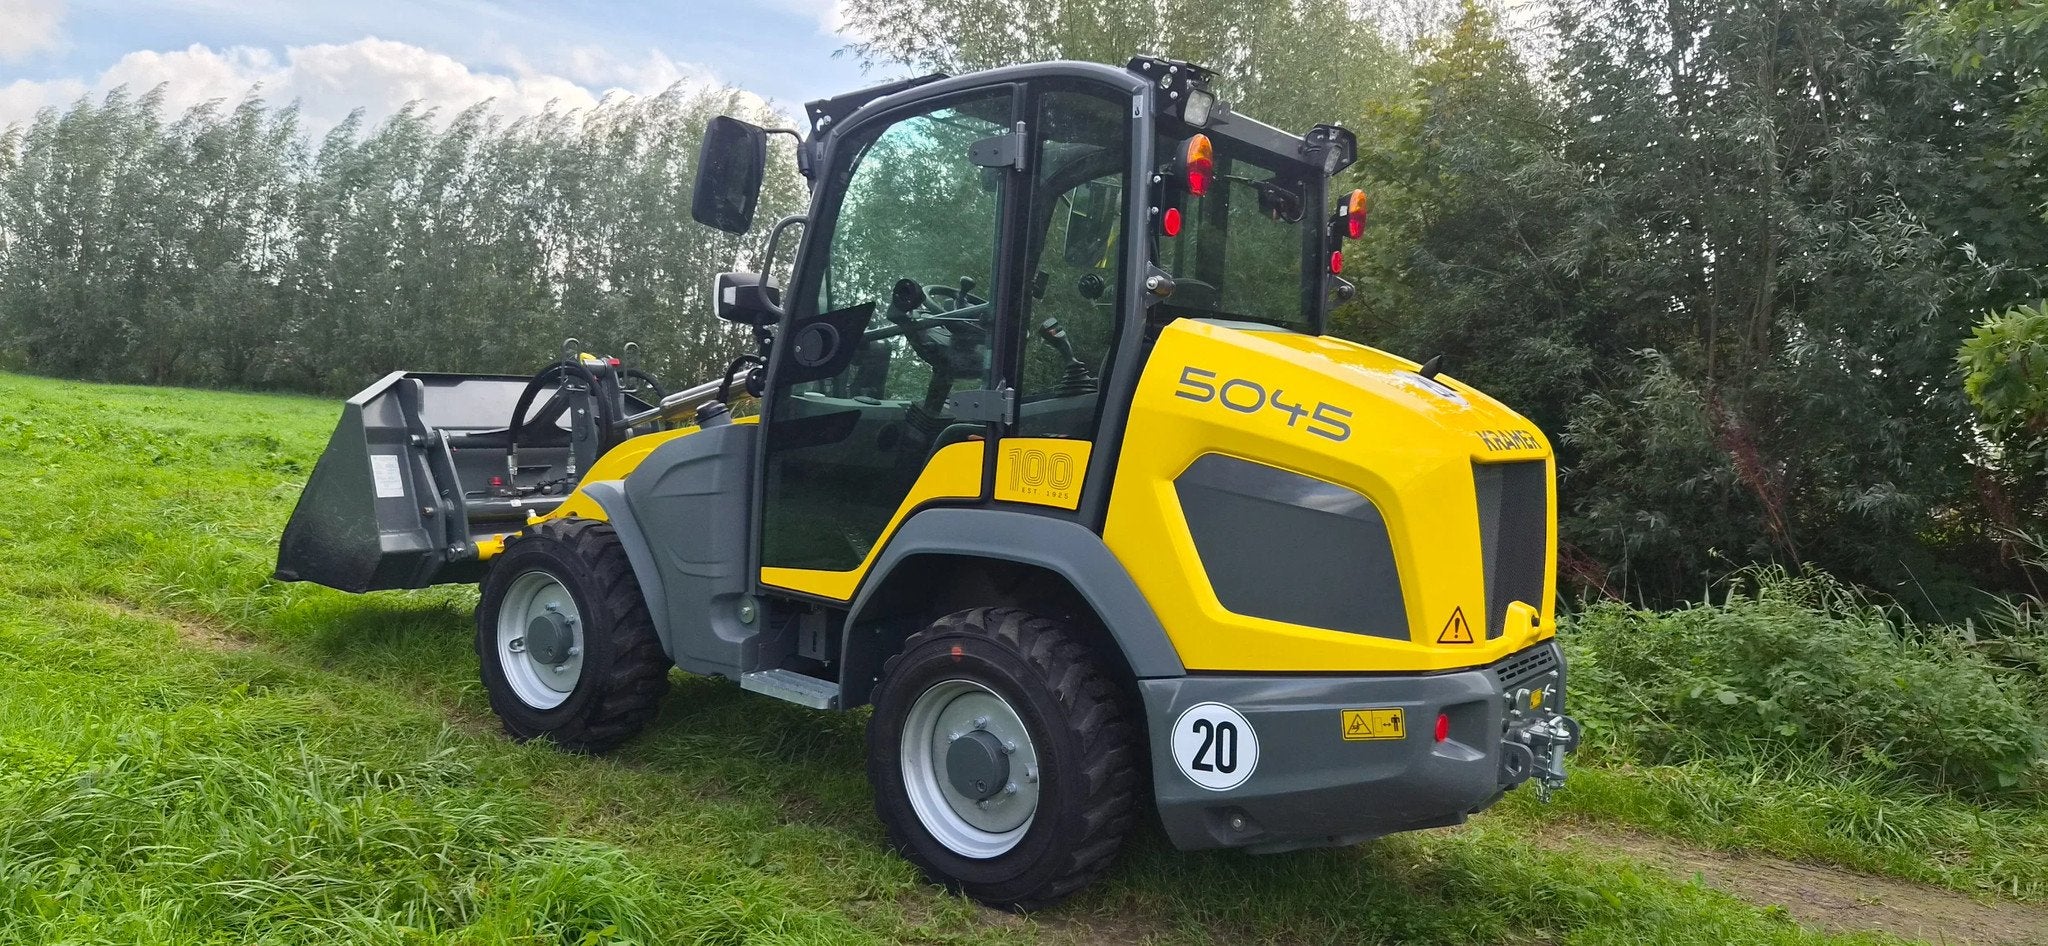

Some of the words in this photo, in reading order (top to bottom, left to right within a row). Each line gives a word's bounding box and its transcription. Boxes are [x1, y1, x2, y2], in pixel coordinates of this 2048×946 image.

[1174, 365, 1353, 442] 5045
[1475, 429, 1542, 451] KRAMER
[1009, 448, 1073, 491] 100
[1046, 490, 1069, 500] 1925
[1192, 718, 1238, 774] 20
